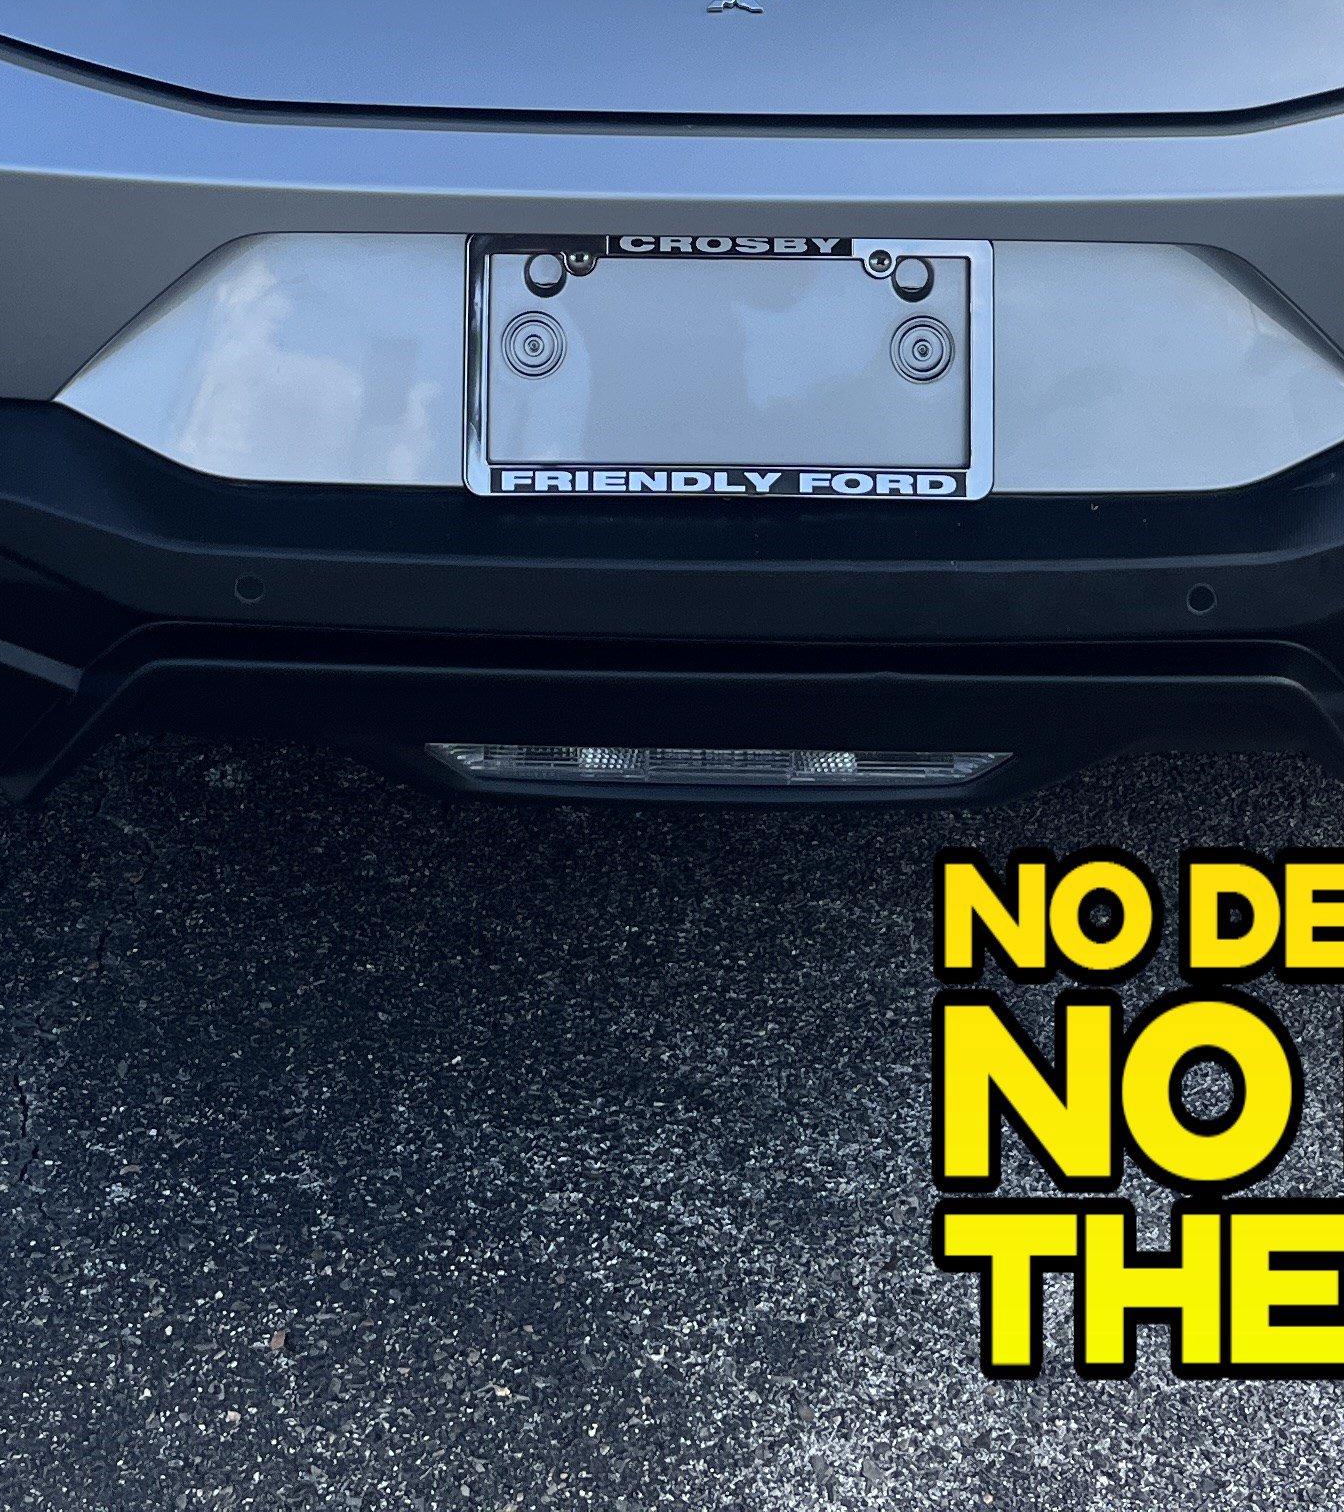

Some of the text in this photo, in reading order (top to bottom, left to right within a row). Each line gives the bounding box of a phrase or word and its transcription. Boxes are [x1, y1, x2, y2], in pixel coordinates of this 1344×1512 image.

[619, 236, 841, 254] CROSBY
[501, 470, 957, 495] FRIENDLY FORD
